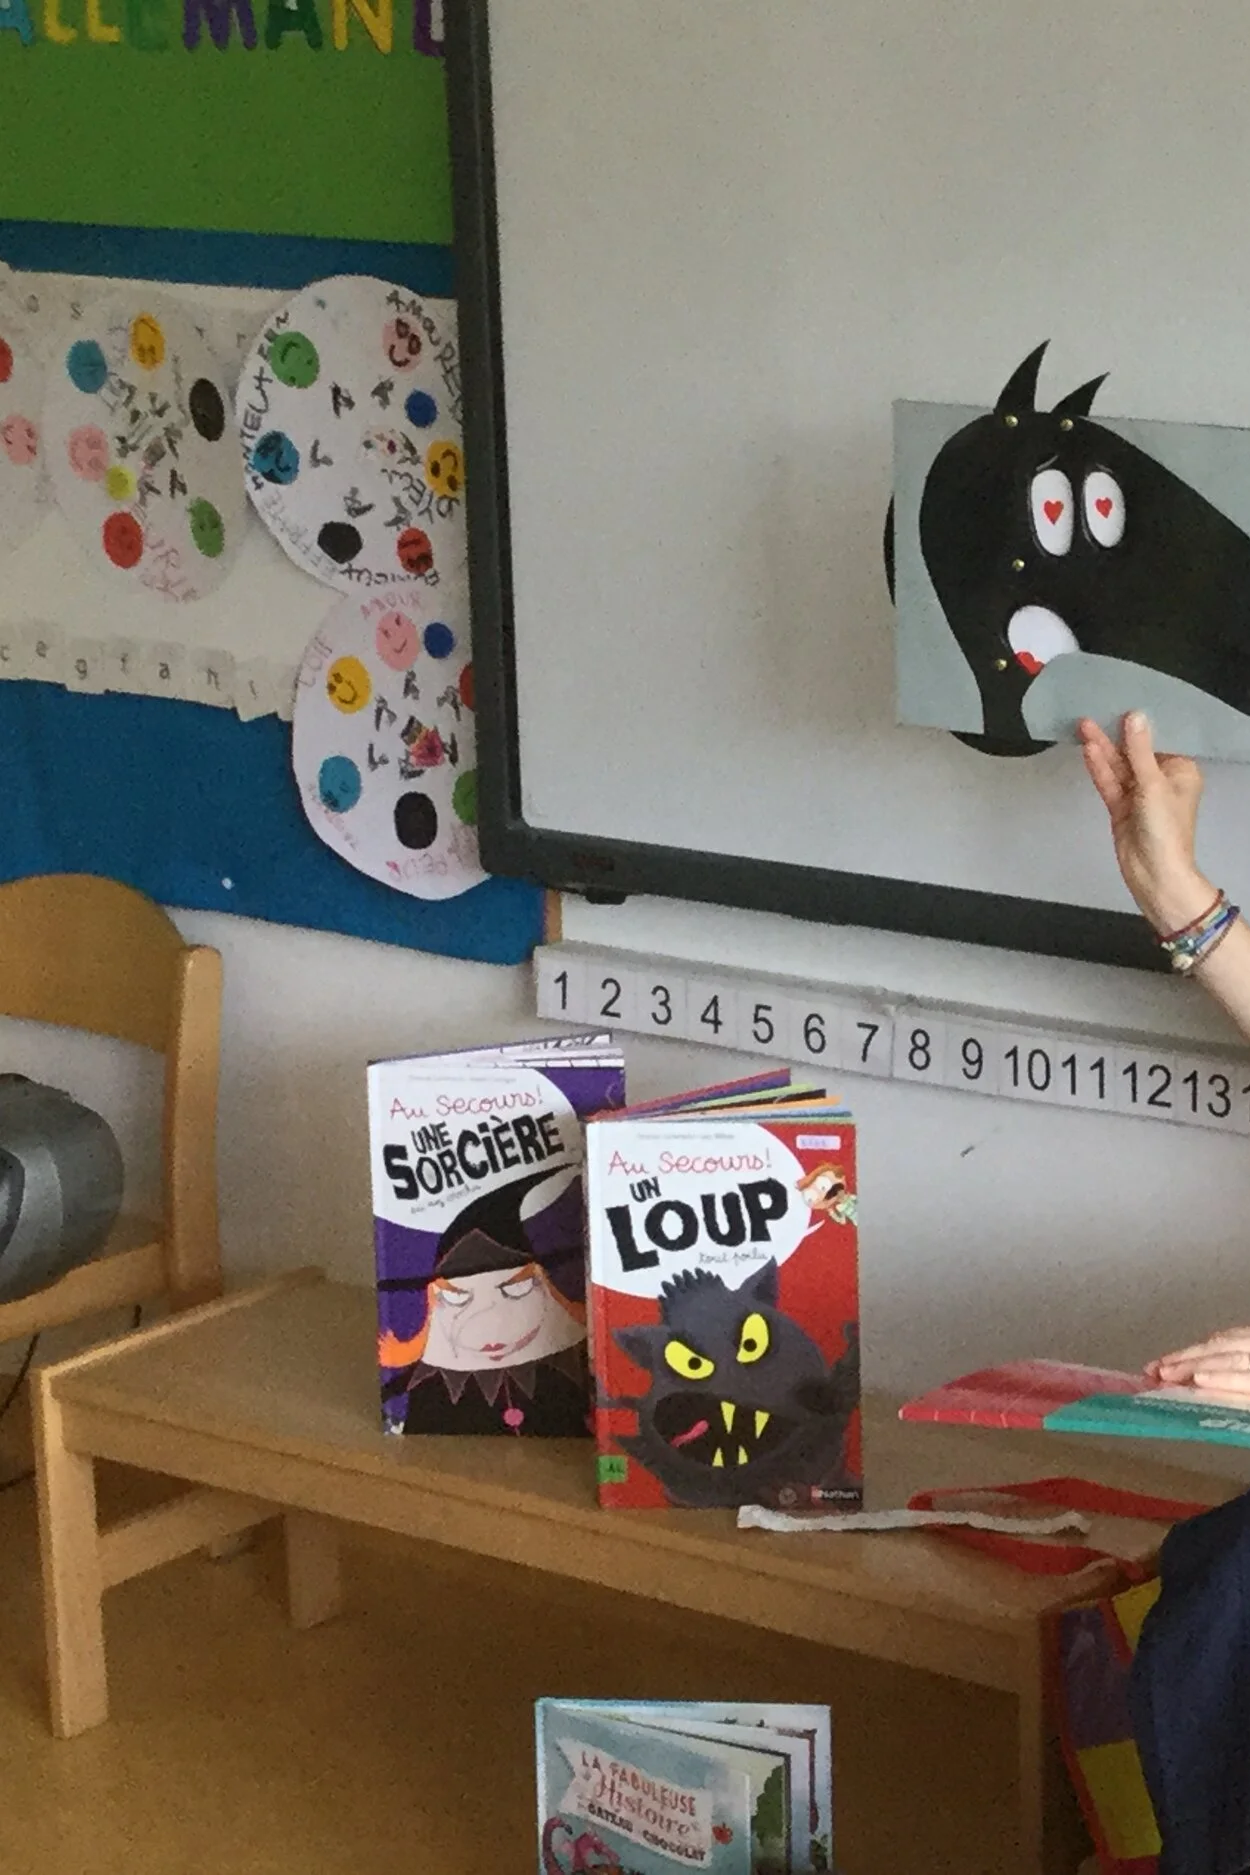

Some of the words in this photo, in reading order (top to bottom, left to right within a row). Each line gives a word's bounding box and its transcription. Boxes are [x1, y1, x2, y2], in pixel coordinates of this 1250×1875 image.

[554, 971, 567, 1010] 1
[600, 978, 622, 1018] 2
[651, 985, 672, 1025] 3
[700, 995, 723, 1034] 4
[753, 1004, 774, 1043] 5
[804, 1014, 826, 1053] 6
[857, 1022, 879, 1062] 7
[909, 1029, 931, 1071] 8
[962, 1038, 983, 1080] 9
[1004, 1045, 1051, 1091] 10
[1062, 1054, 1105, 1099] 11
[1122, 1061, 1172, 1108] 12
[1182, 1070, 1232, 1118] 13
[390, 1097, 428, 1120] Au
[411, 1121, 453, 1154] UNE
[608, 1150, 649, 1176] Au
[629, 1176, 662, 1203] UN
[605, 1177, 789, 1273] LOUP
[581, 1751, 601, 1771] LA
[610, 1761, 697, 1817] FABULEUSE
